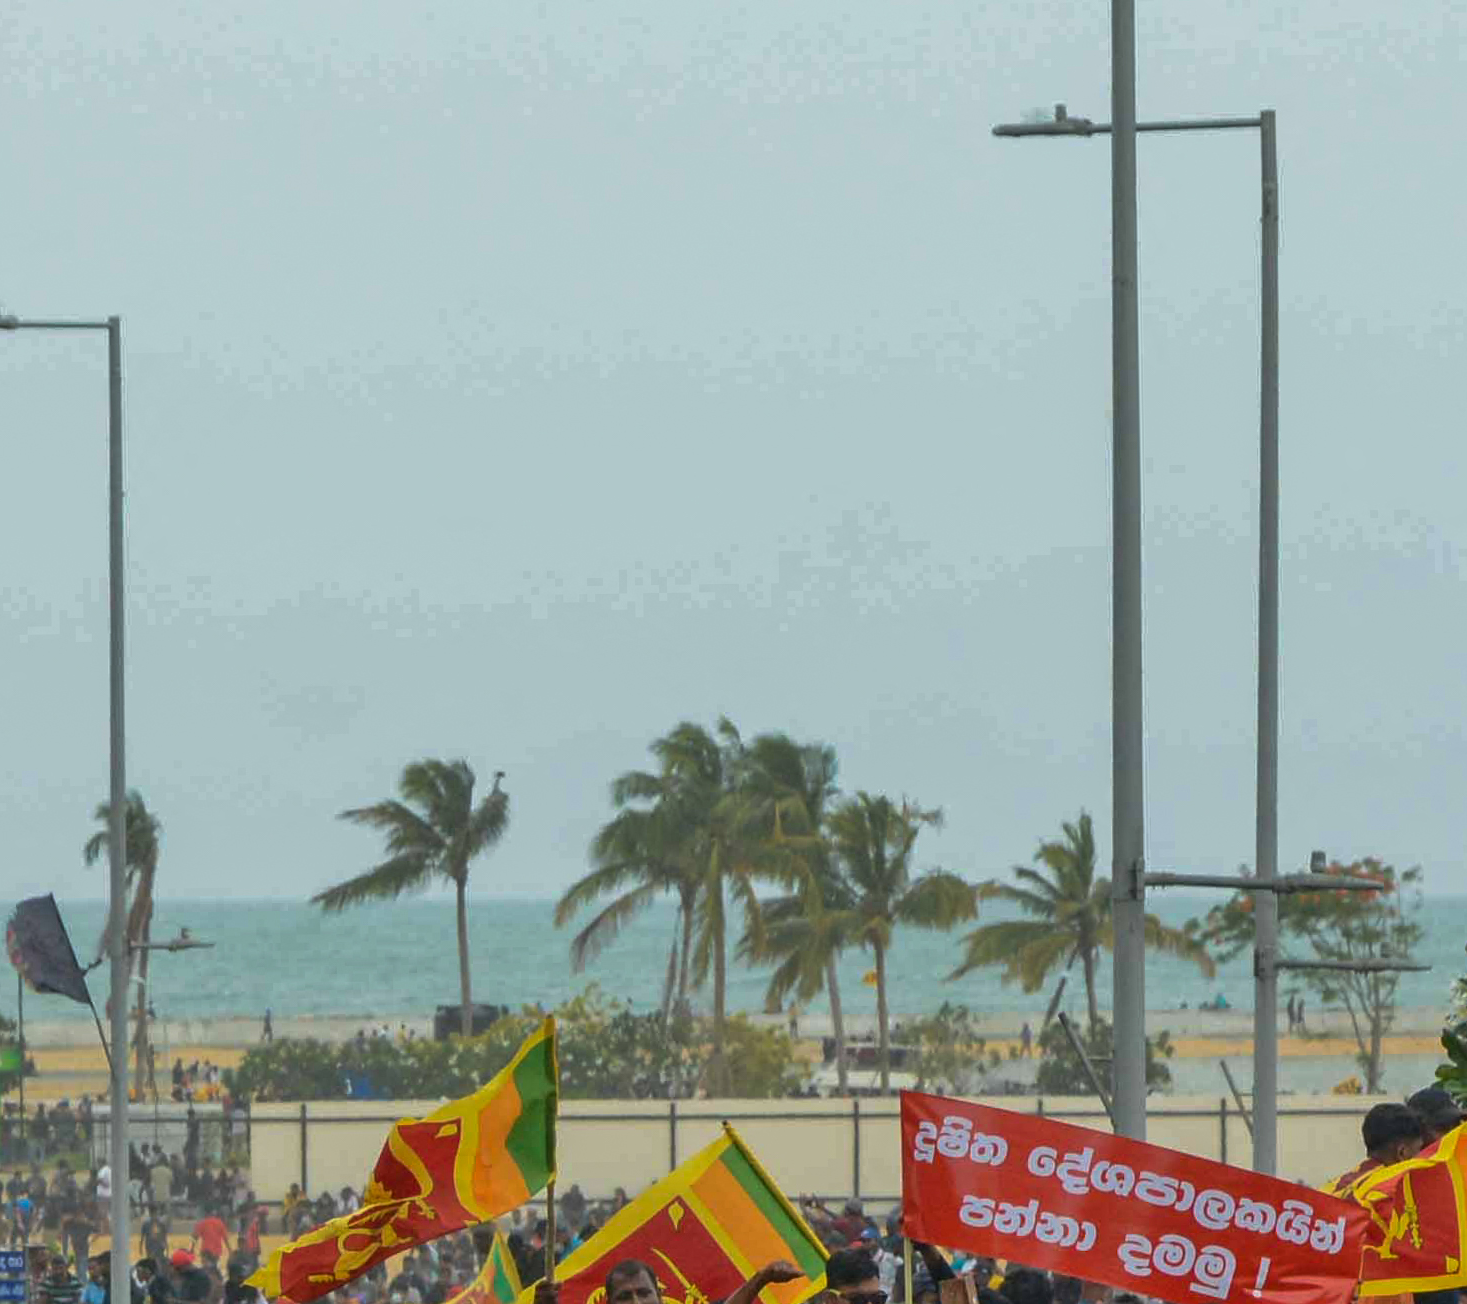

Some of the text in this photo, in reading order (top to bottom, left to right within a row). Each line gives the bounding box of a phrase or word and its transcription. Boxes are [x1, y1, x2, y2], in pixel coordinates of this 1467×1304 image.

[913, 1115, 1346, 1255] දූෂිත දේශපාලකයින්
[958, 1193, 1097, 1252] පන්නා
[1116, 1233, 1237, 1300] දමමු
